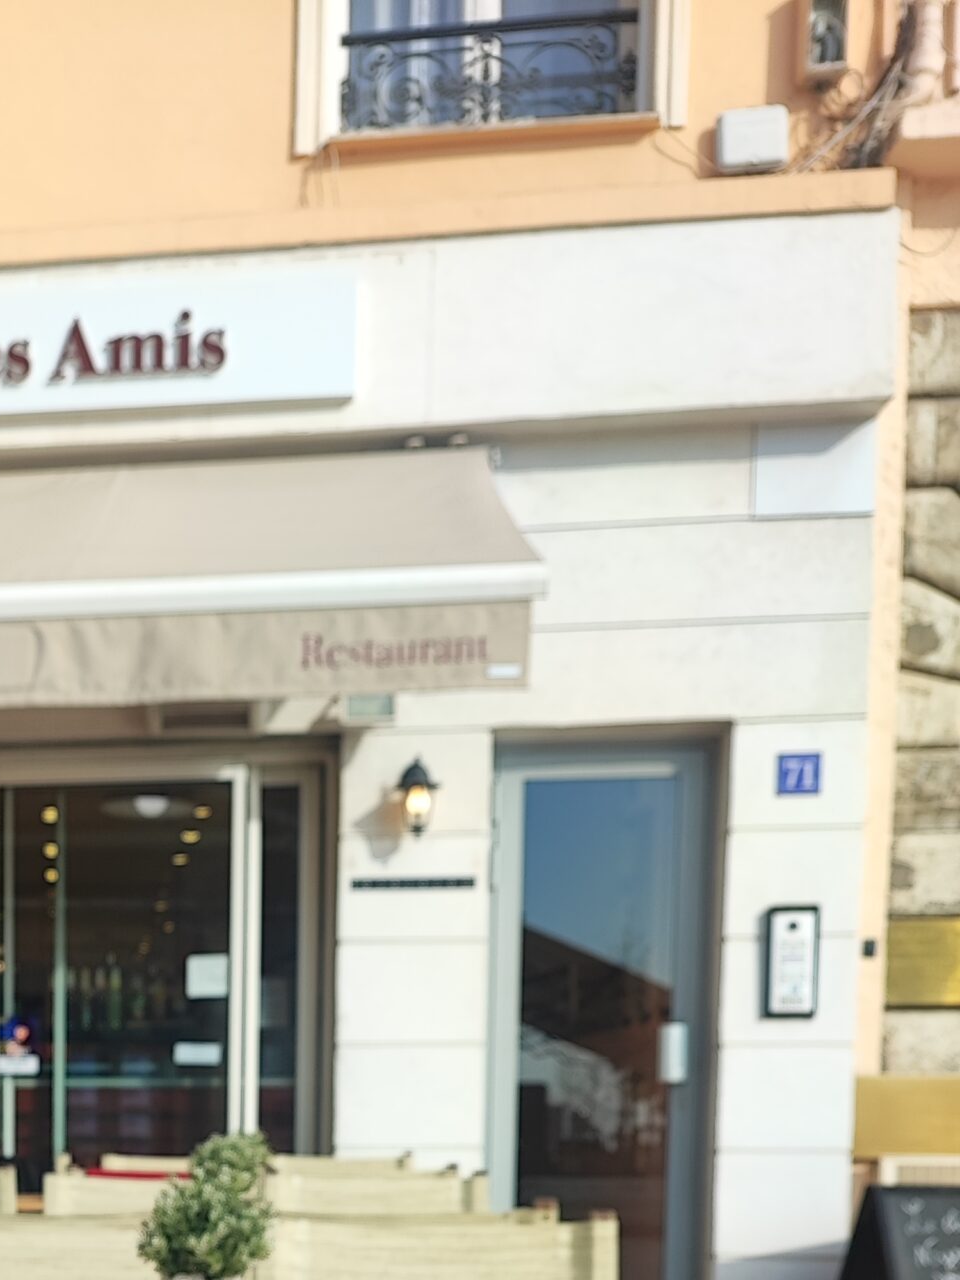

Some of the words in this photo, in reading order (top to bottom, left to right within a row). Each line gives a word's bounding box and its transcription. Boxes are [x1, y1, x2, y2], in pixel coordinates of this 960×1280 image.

[49, 309, 228, 385] Amis
[300, 631, 489, 671] Restaurant
[782, 760, 816, 791] 71
